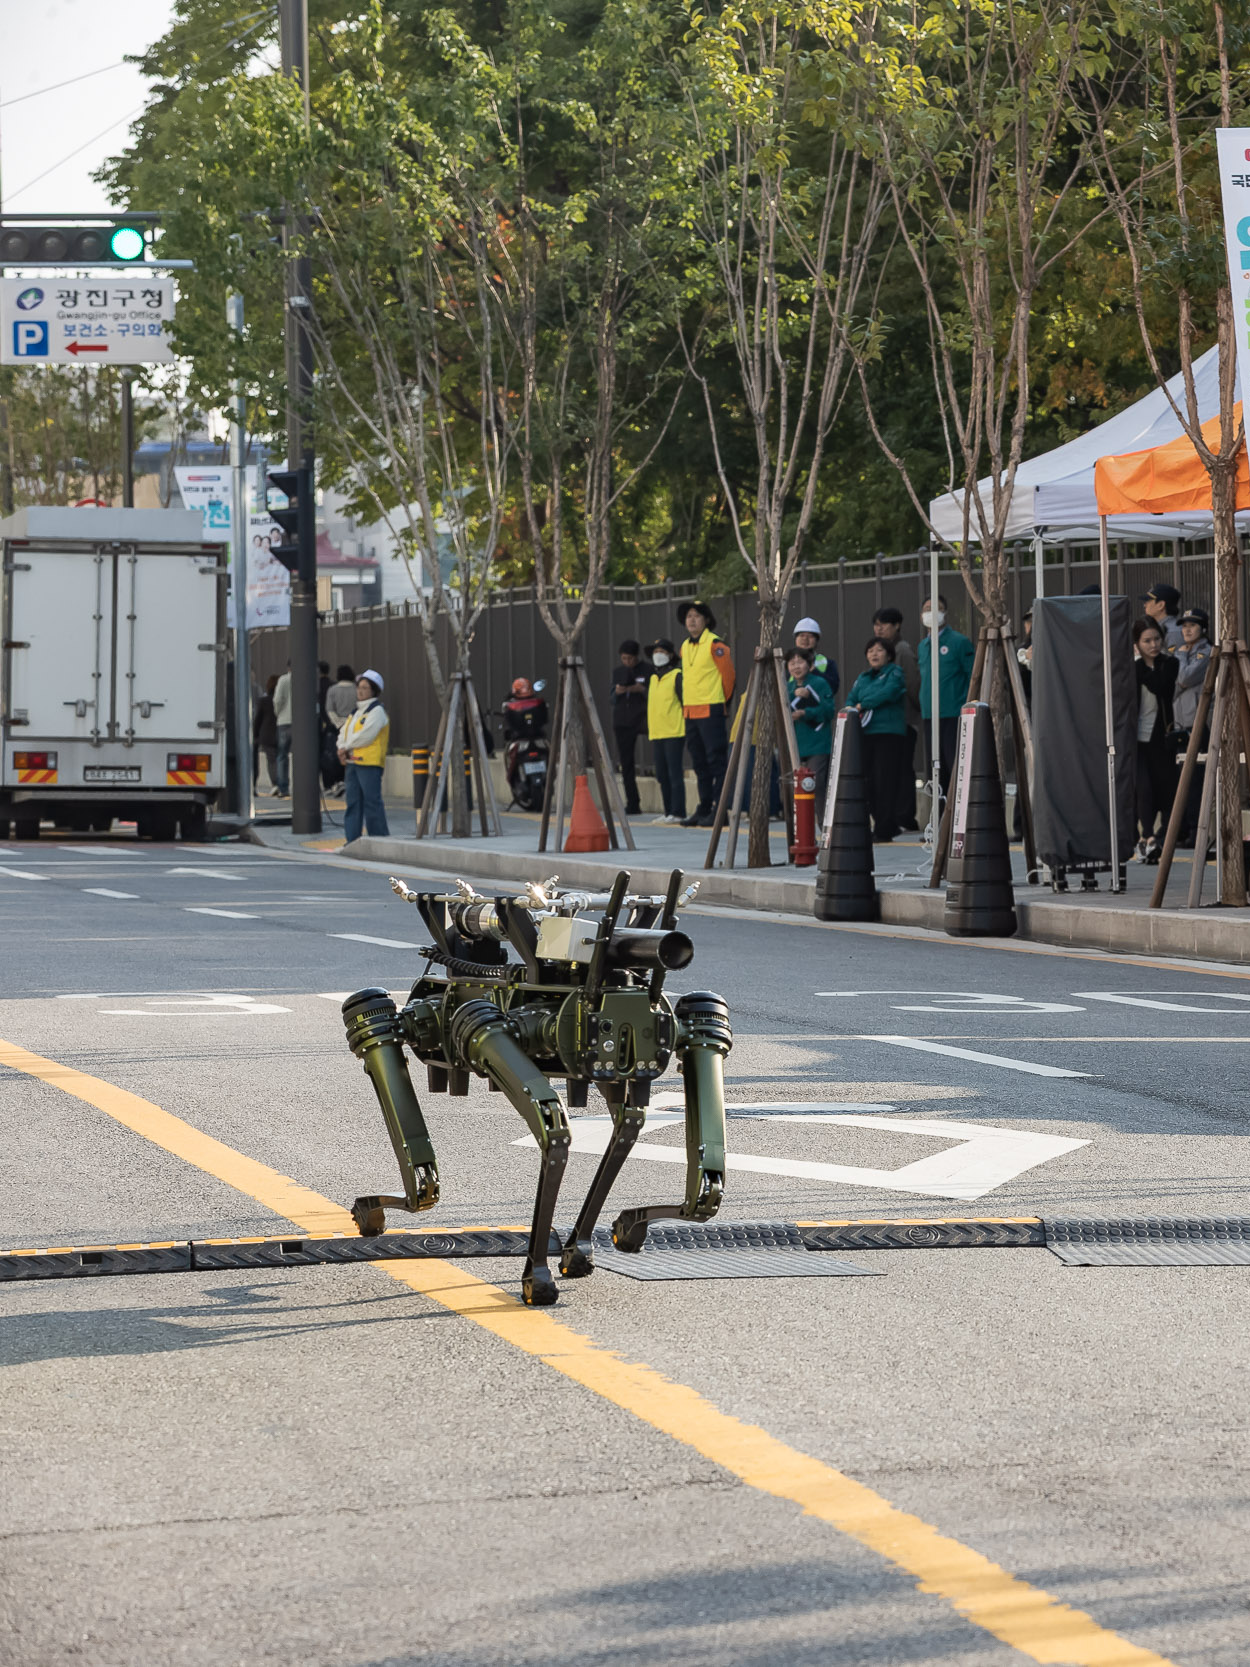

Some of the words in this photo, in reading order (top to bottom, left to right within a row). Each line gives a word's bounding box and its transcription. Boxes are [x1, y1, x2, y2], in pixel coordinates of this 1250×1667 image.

[56, 289, 163, 308] 광진구청
[57, 310, 126, 320] Gwangjin-gu
[129, 310, 161, 320] Office
